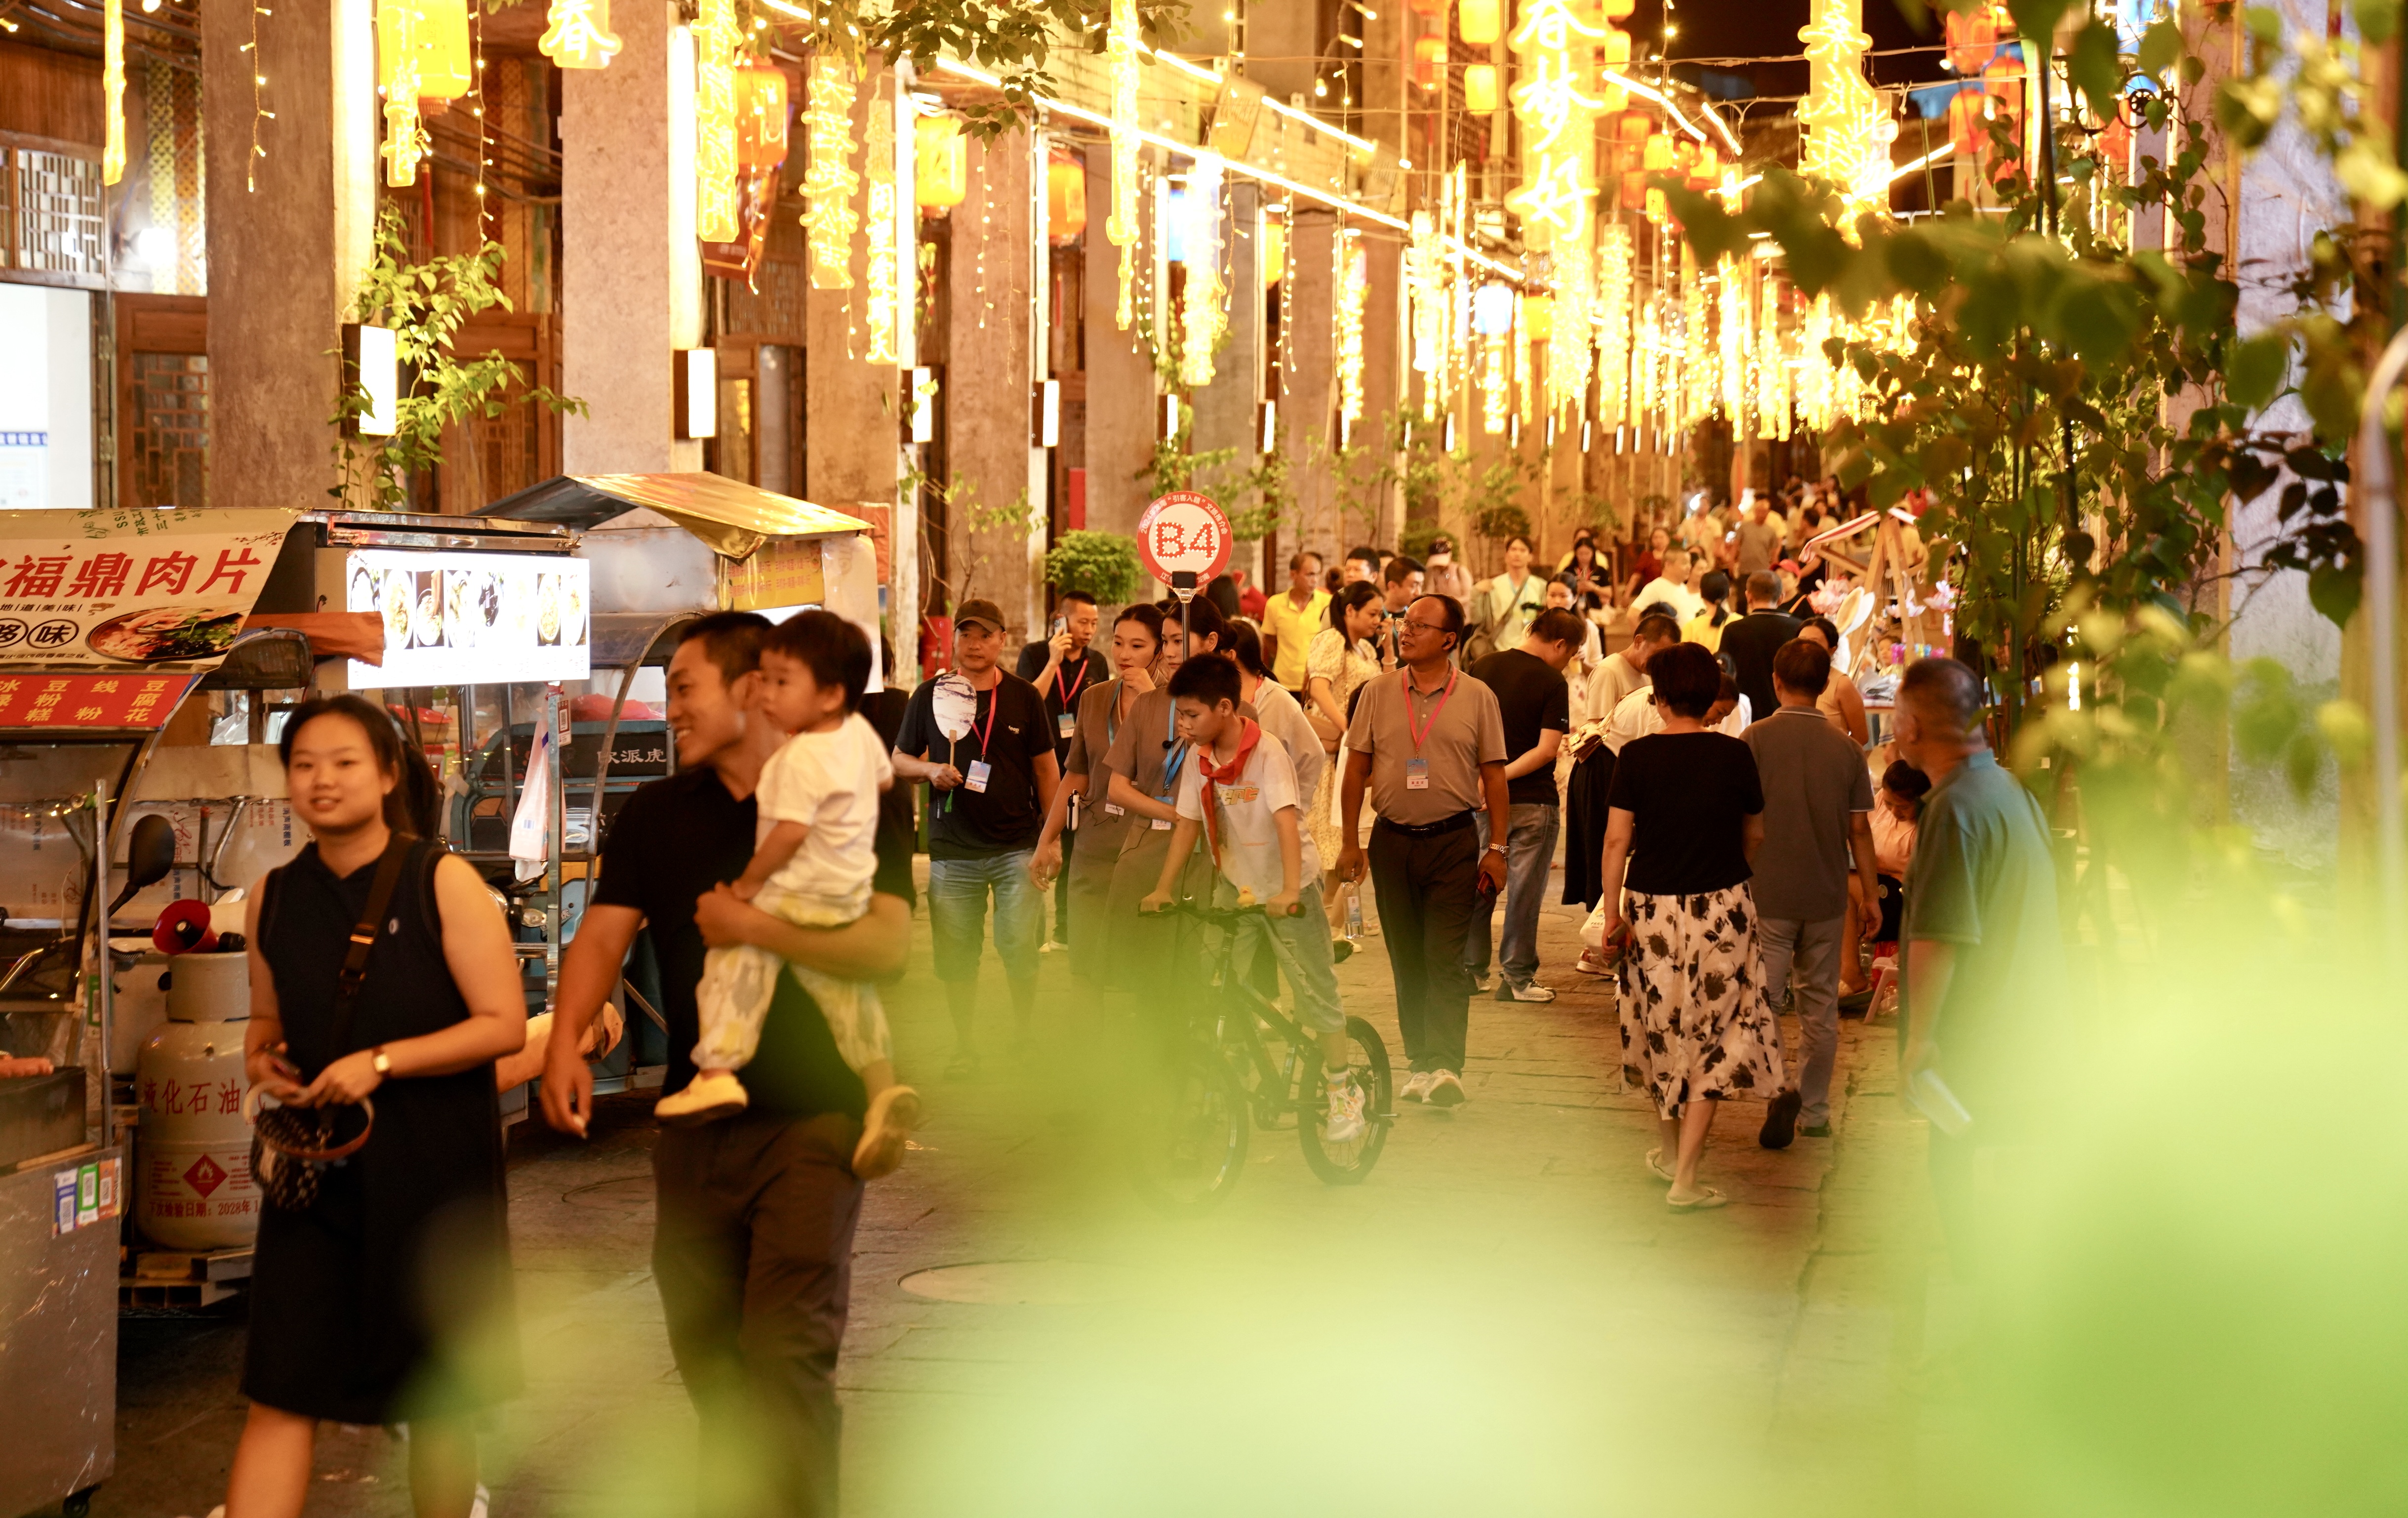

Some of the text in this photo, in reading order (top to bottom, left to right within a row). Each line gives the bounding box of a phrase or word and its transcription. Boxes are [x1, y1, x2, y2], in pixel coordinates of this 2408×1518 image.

[1155, 521, 1218, 561] B4
[0, 548, 262, 598] 福鼎肉片
